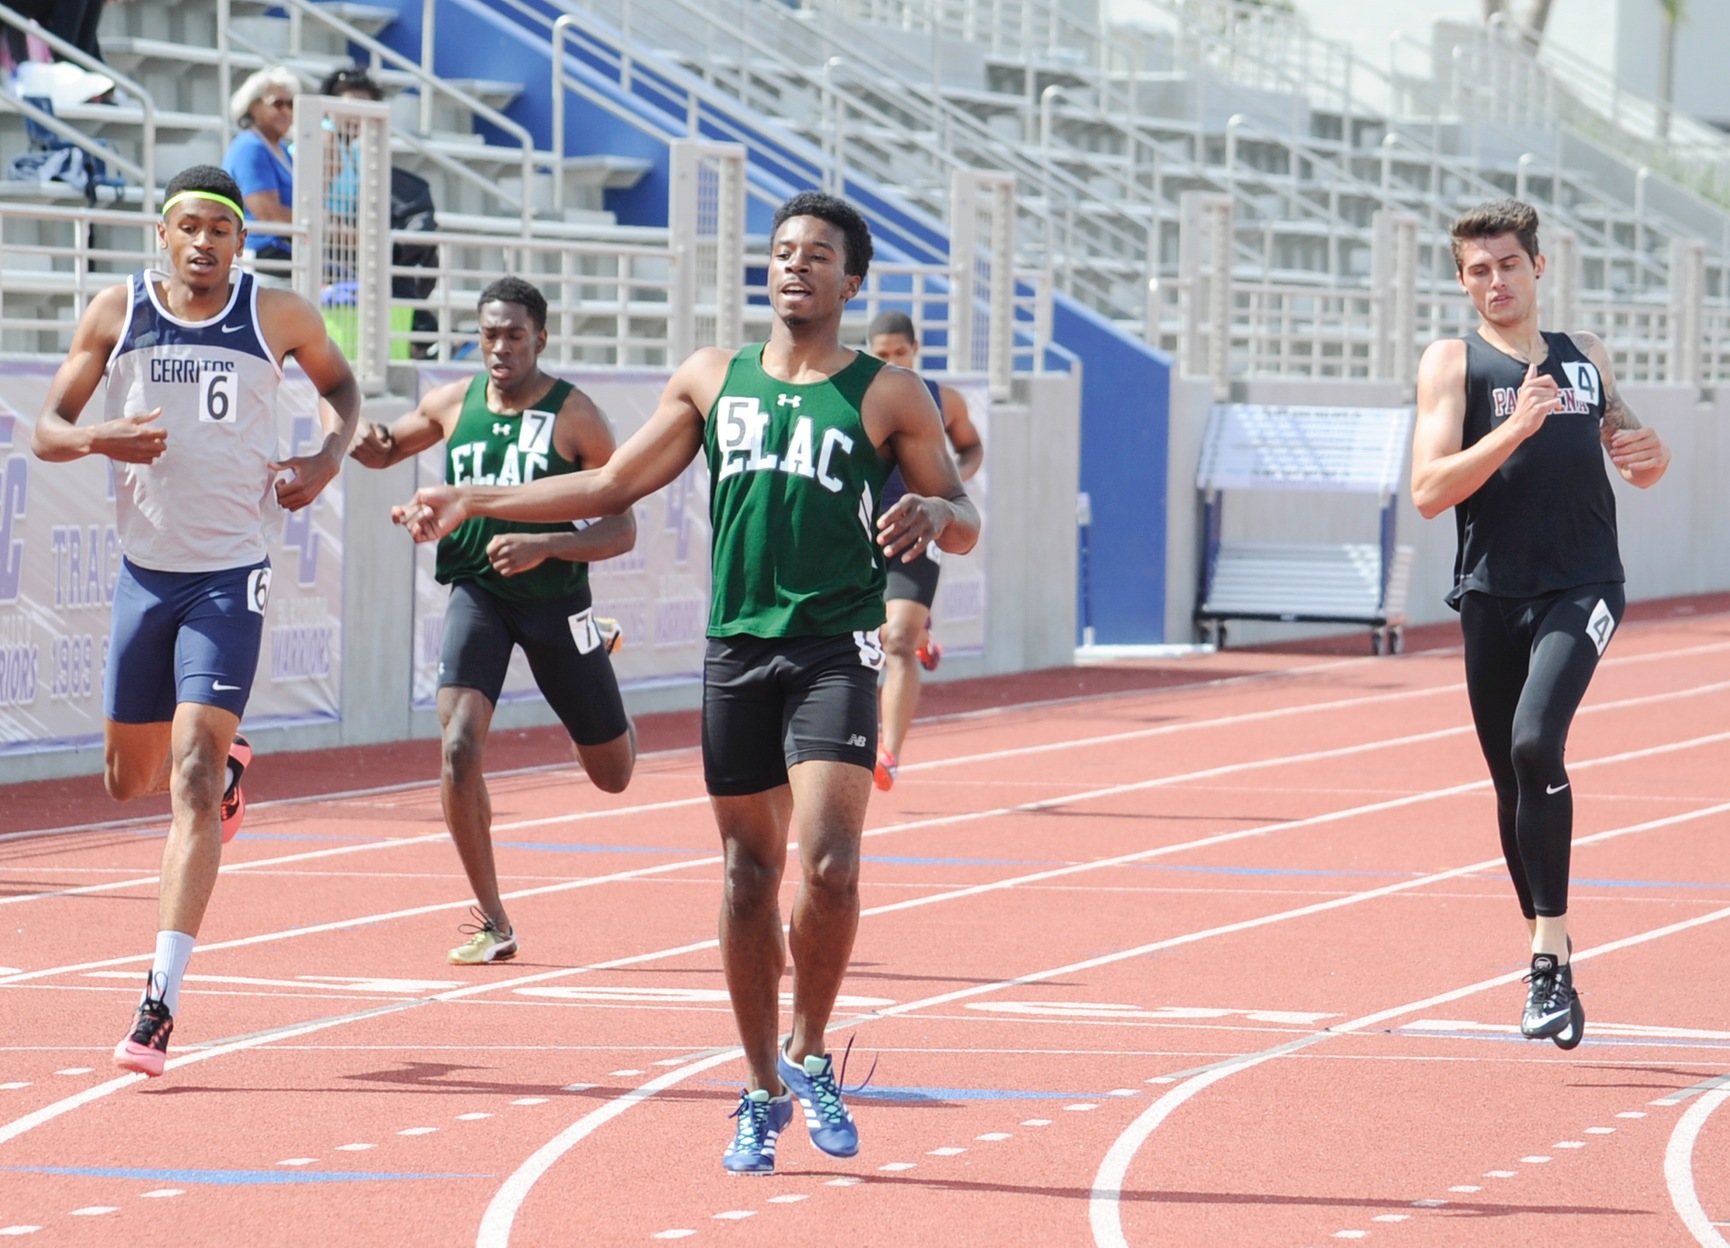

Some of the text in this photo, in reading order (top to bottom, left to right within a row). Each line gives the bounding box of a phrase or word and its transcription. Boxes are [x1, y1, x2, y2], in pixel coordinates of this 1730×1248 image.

[207, 375, 229, 420] 6
[1578, 365, 1595, 400] 4
[529, 414, 548, 448] 7
[726, 401, 747, 448] 5
[451, 441, 549, 488] ELAC
[719, 411, 855, 493] ELAC
[254, 569, 269, 612] 6
[576, 612, 597, 648] 7
[1592, 614, 1611, 647] 4
